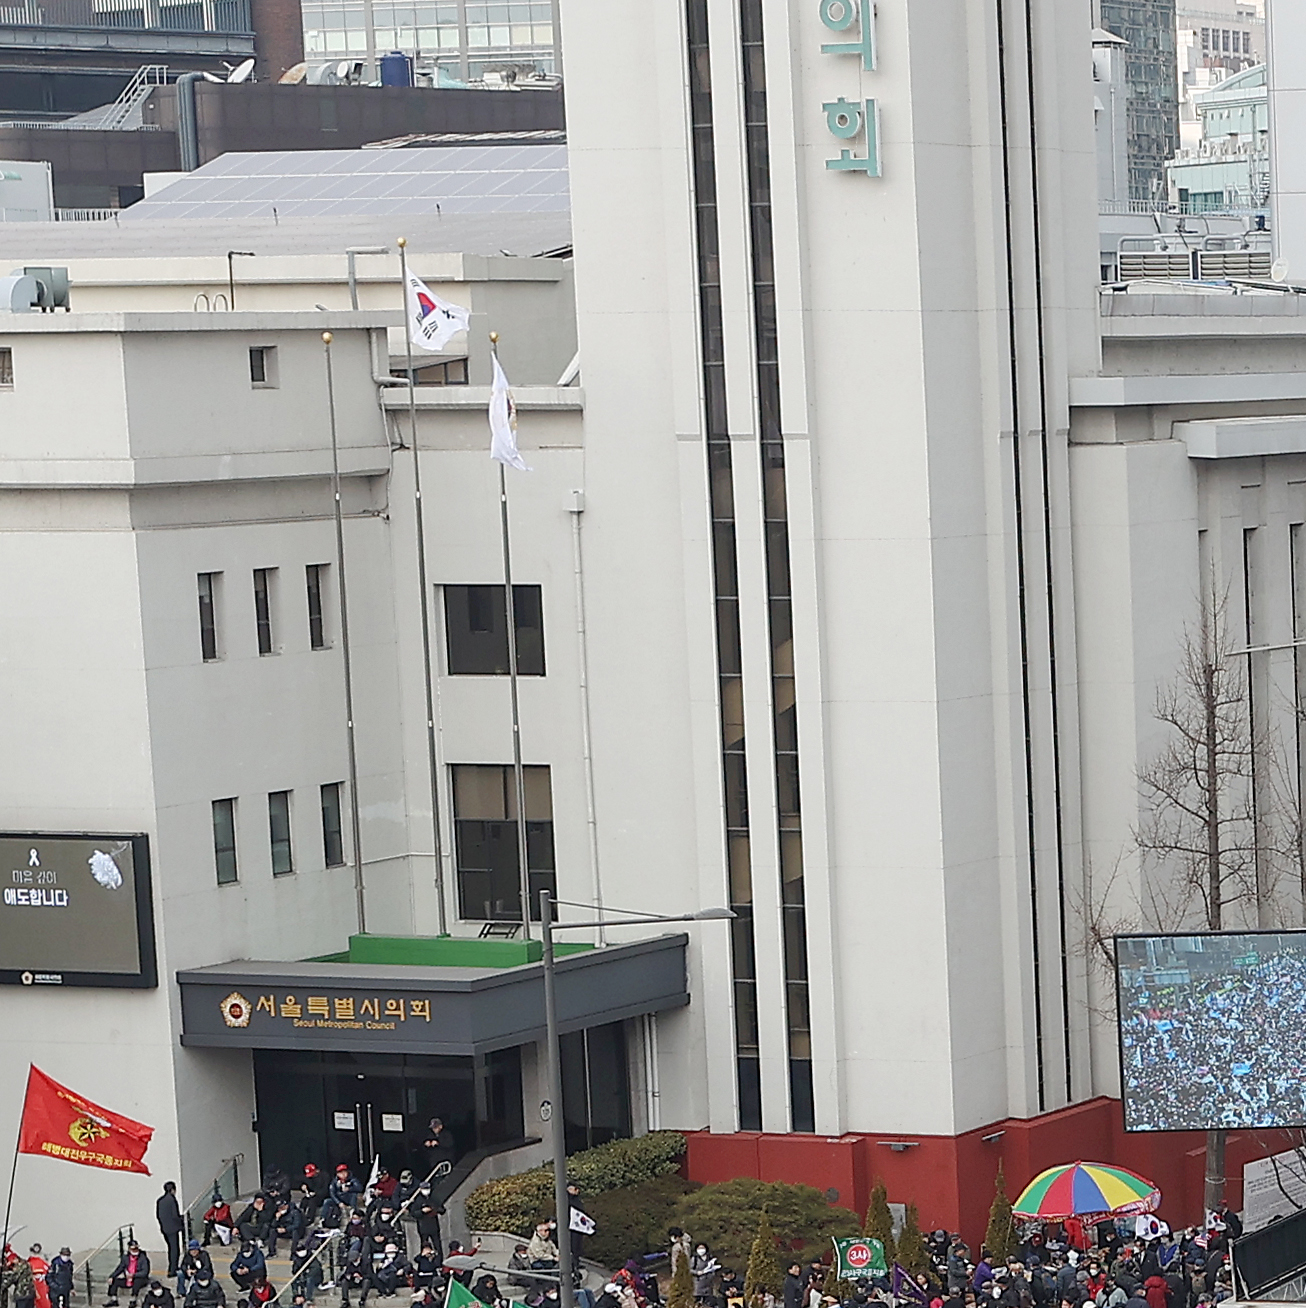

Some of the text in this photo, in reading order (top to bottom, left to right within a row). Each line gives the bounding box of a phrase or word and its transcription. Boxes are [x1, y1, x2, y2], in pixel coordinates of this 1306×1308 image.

[4, 888, 69, 907] 애도합니다
[256, 994, 432, 1022] 서울특별시의회
[293, 1018, 396, 1031] Seoul Metropolitan Council
